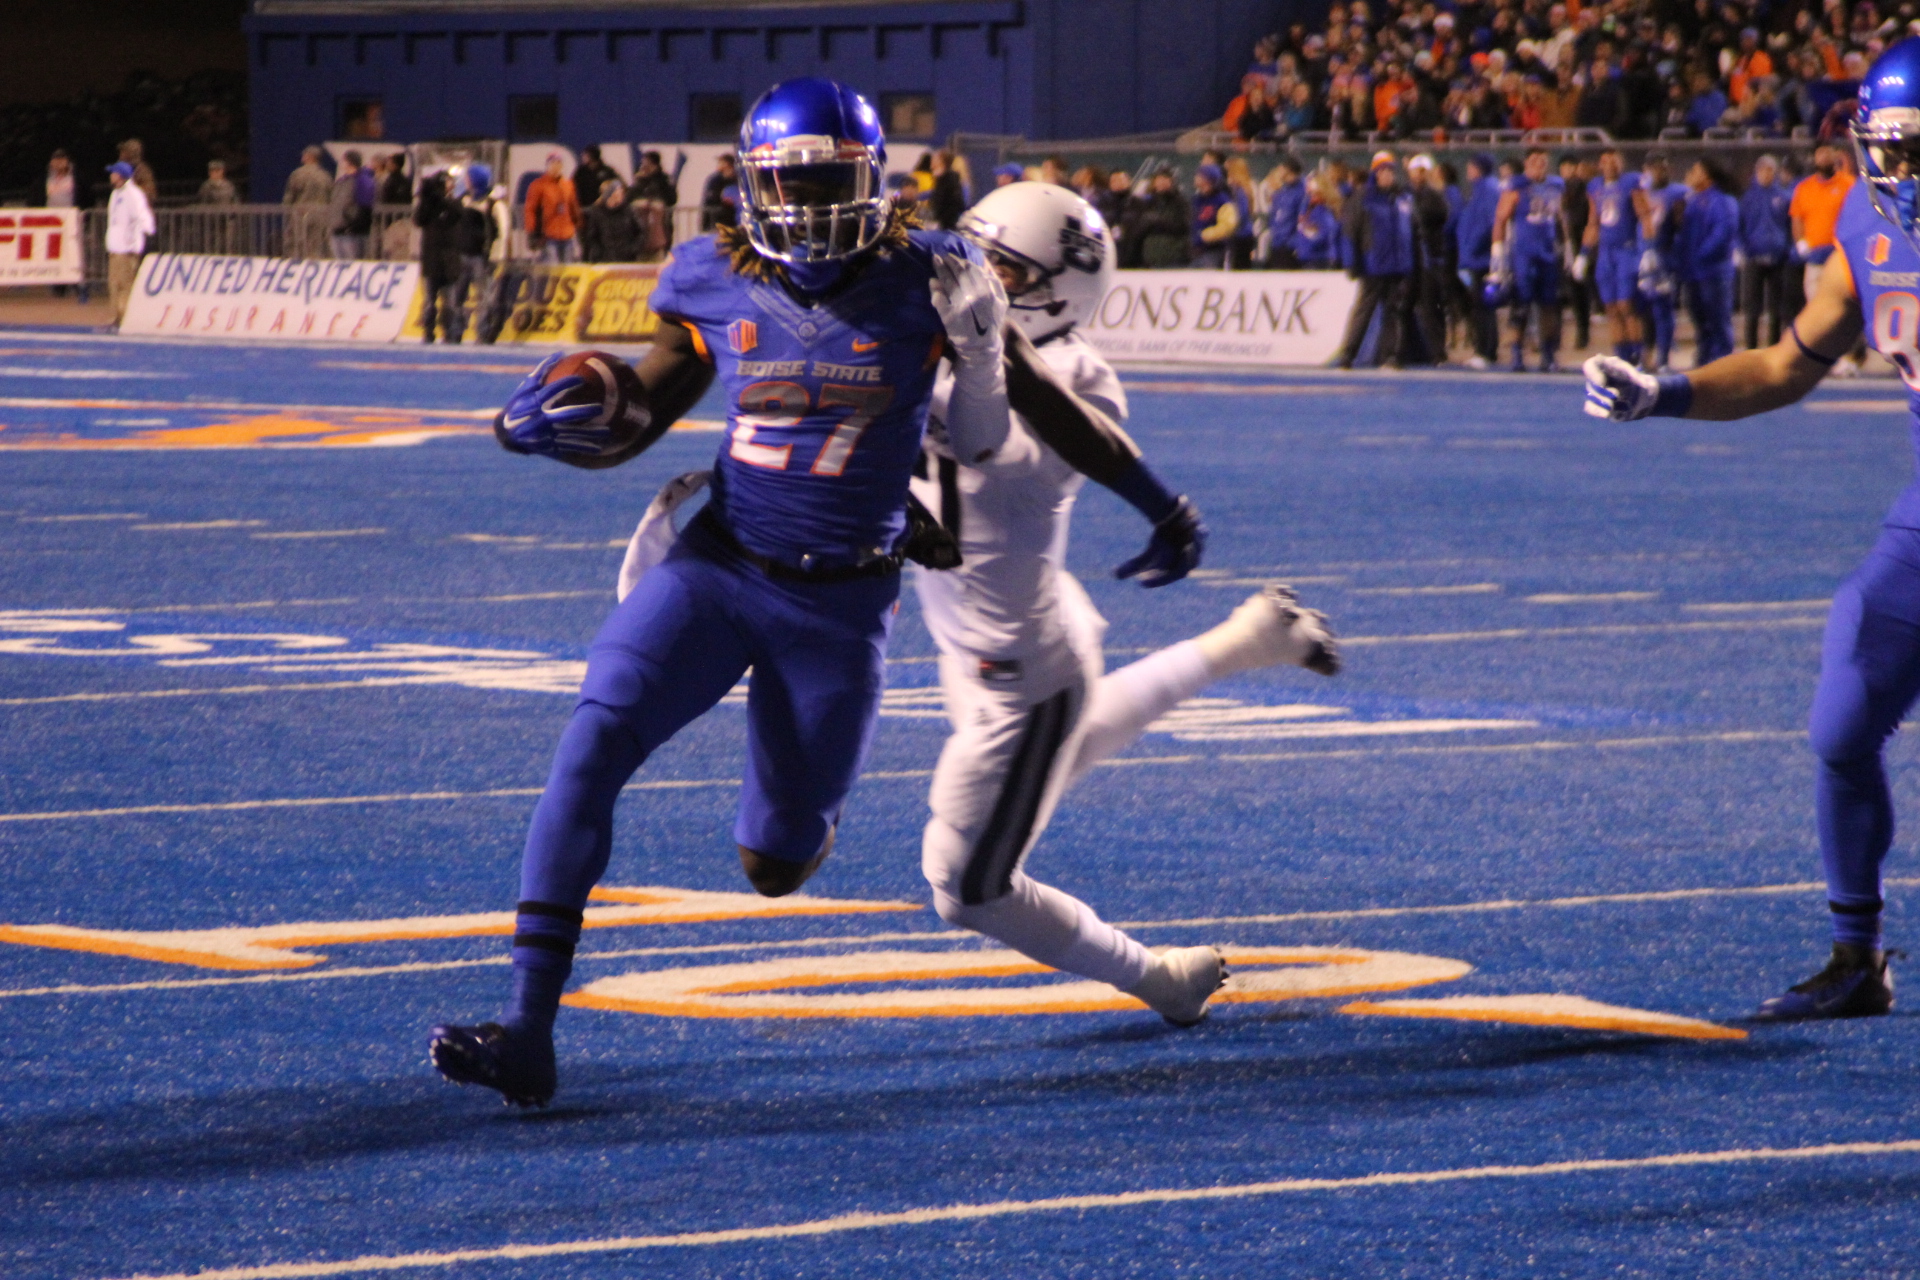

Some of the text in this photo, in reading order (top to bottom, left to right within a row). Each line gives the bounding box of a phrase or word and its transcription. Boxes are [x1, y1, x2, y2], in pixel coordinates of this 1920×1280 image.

[144, 252, 407, 310] UNITED HERITAGE
[156, 303, 370, 338] INSURANCE
[586, 300, 660, 335] IDA
[1088, 284, 1321, 335] IONS BANK
[736, 360, 883, 381] BOISE STATE
[729, 380, 895, 477] 27
